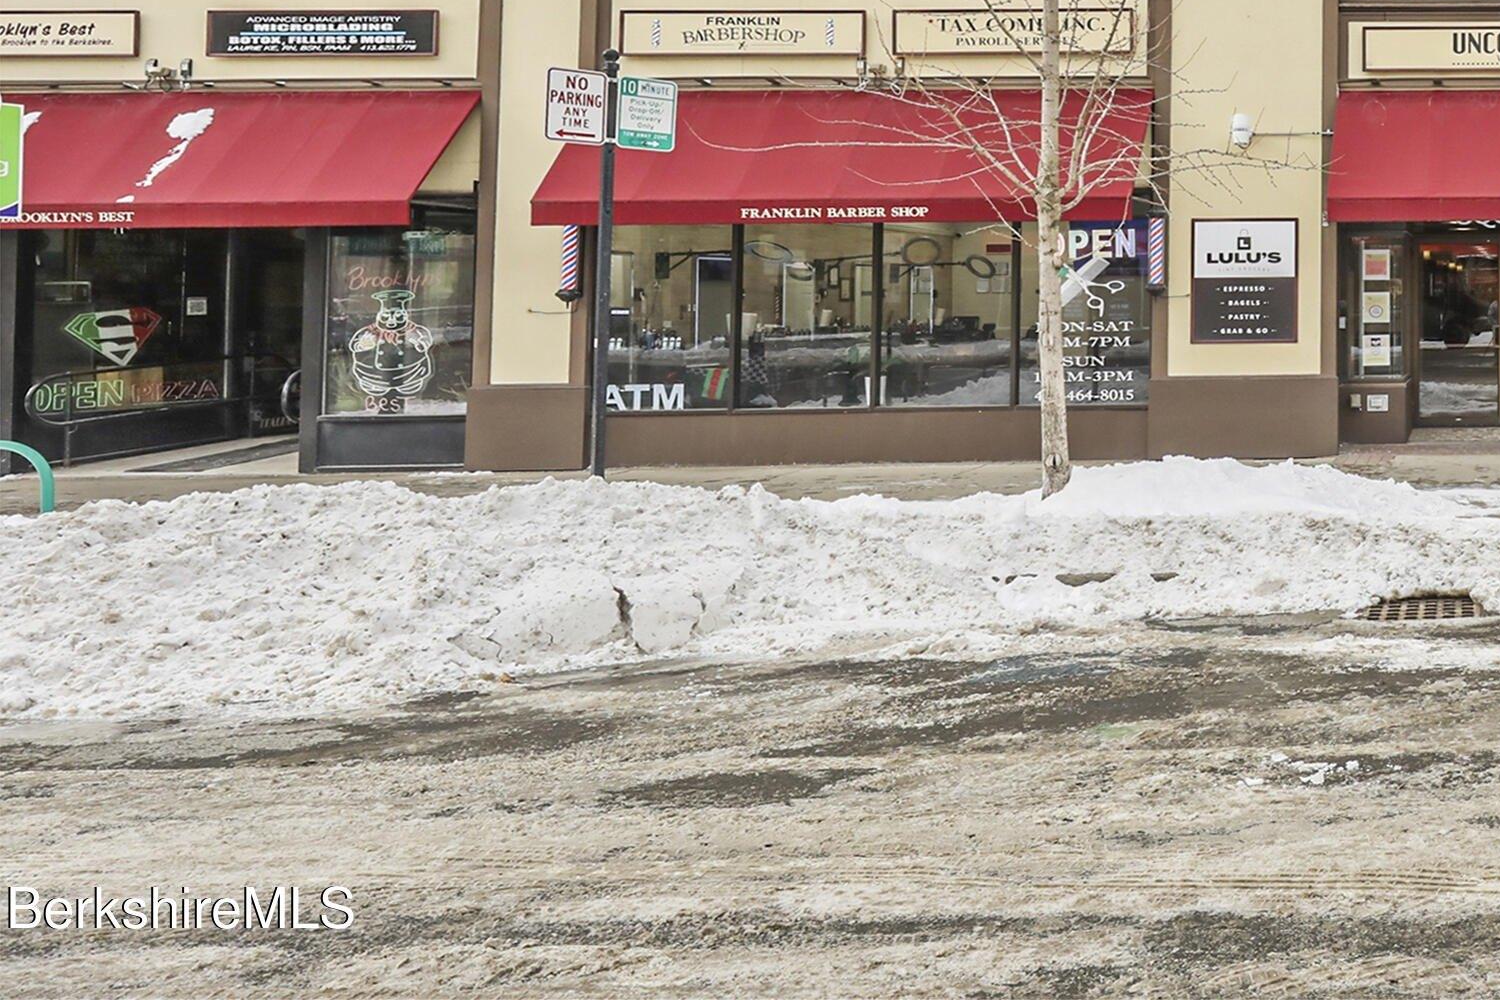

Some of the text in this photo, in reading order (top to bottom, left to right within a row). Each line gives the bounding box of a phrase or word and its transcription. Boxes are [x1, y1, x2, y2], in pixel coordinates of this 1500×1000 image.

[253, 23, 394, 32] MICROBLADING
[706, 17, 781, 26] FRANKLIN
[937, 18, 976, 32] TAX
[58, 23, 96, 36] Best
[682, 27, 806, 44] BARBERSHOP
[228, 36, 285, 45] BOTOX,
[288, 36, 347, 44] FILLERS
[956, 37, 1011, 46] PAYROLL
[566, 75, 589, 91] NO
[622, 79, 637, 94] 10
[550, 89, 602, 109] PARKING
[564, 107, 588, 117] ANY
[562, 117, 590, 129] TIME
[99, 212, 135, 222] BEST
[741, 207, 929, 218] FRANKLIN BARBER SHOP
[1207, 252, 1282, 264] LULU'S
[1062, 356, 1106, 367] SUN
[35, 379, 219, 412] OPEN PIZZA
[606, 383, 684, 410] ATM
